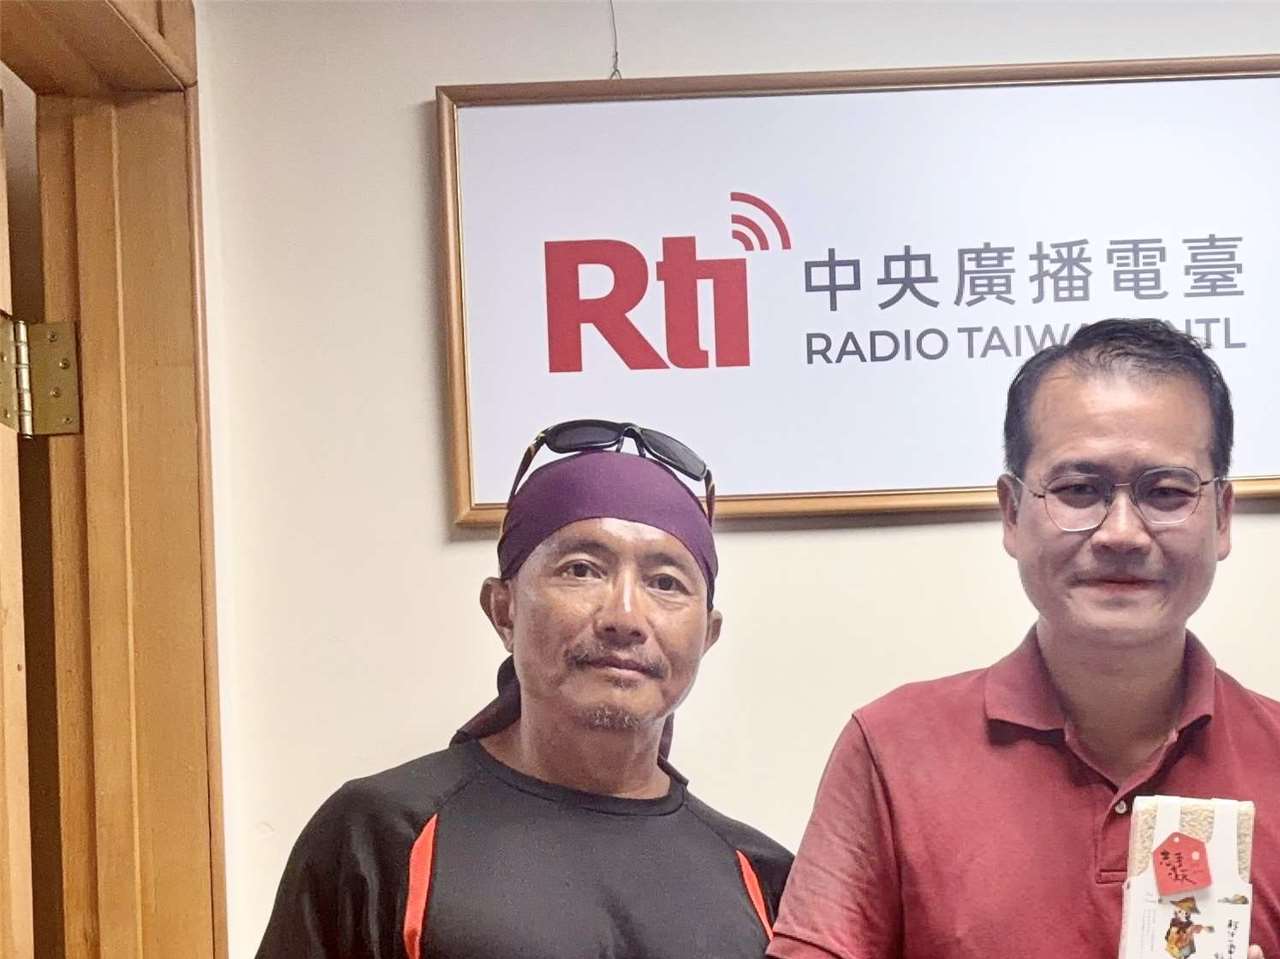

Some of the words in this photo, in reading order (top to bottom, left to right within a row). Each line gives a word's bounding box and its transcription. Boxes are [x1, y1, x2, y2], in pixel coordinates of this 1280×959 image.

[804, 234, 1246, 311] 中央廣播電臺
[805, 328, 949, 365] RADIO
[957, 322, 1093, 359] TAIW
